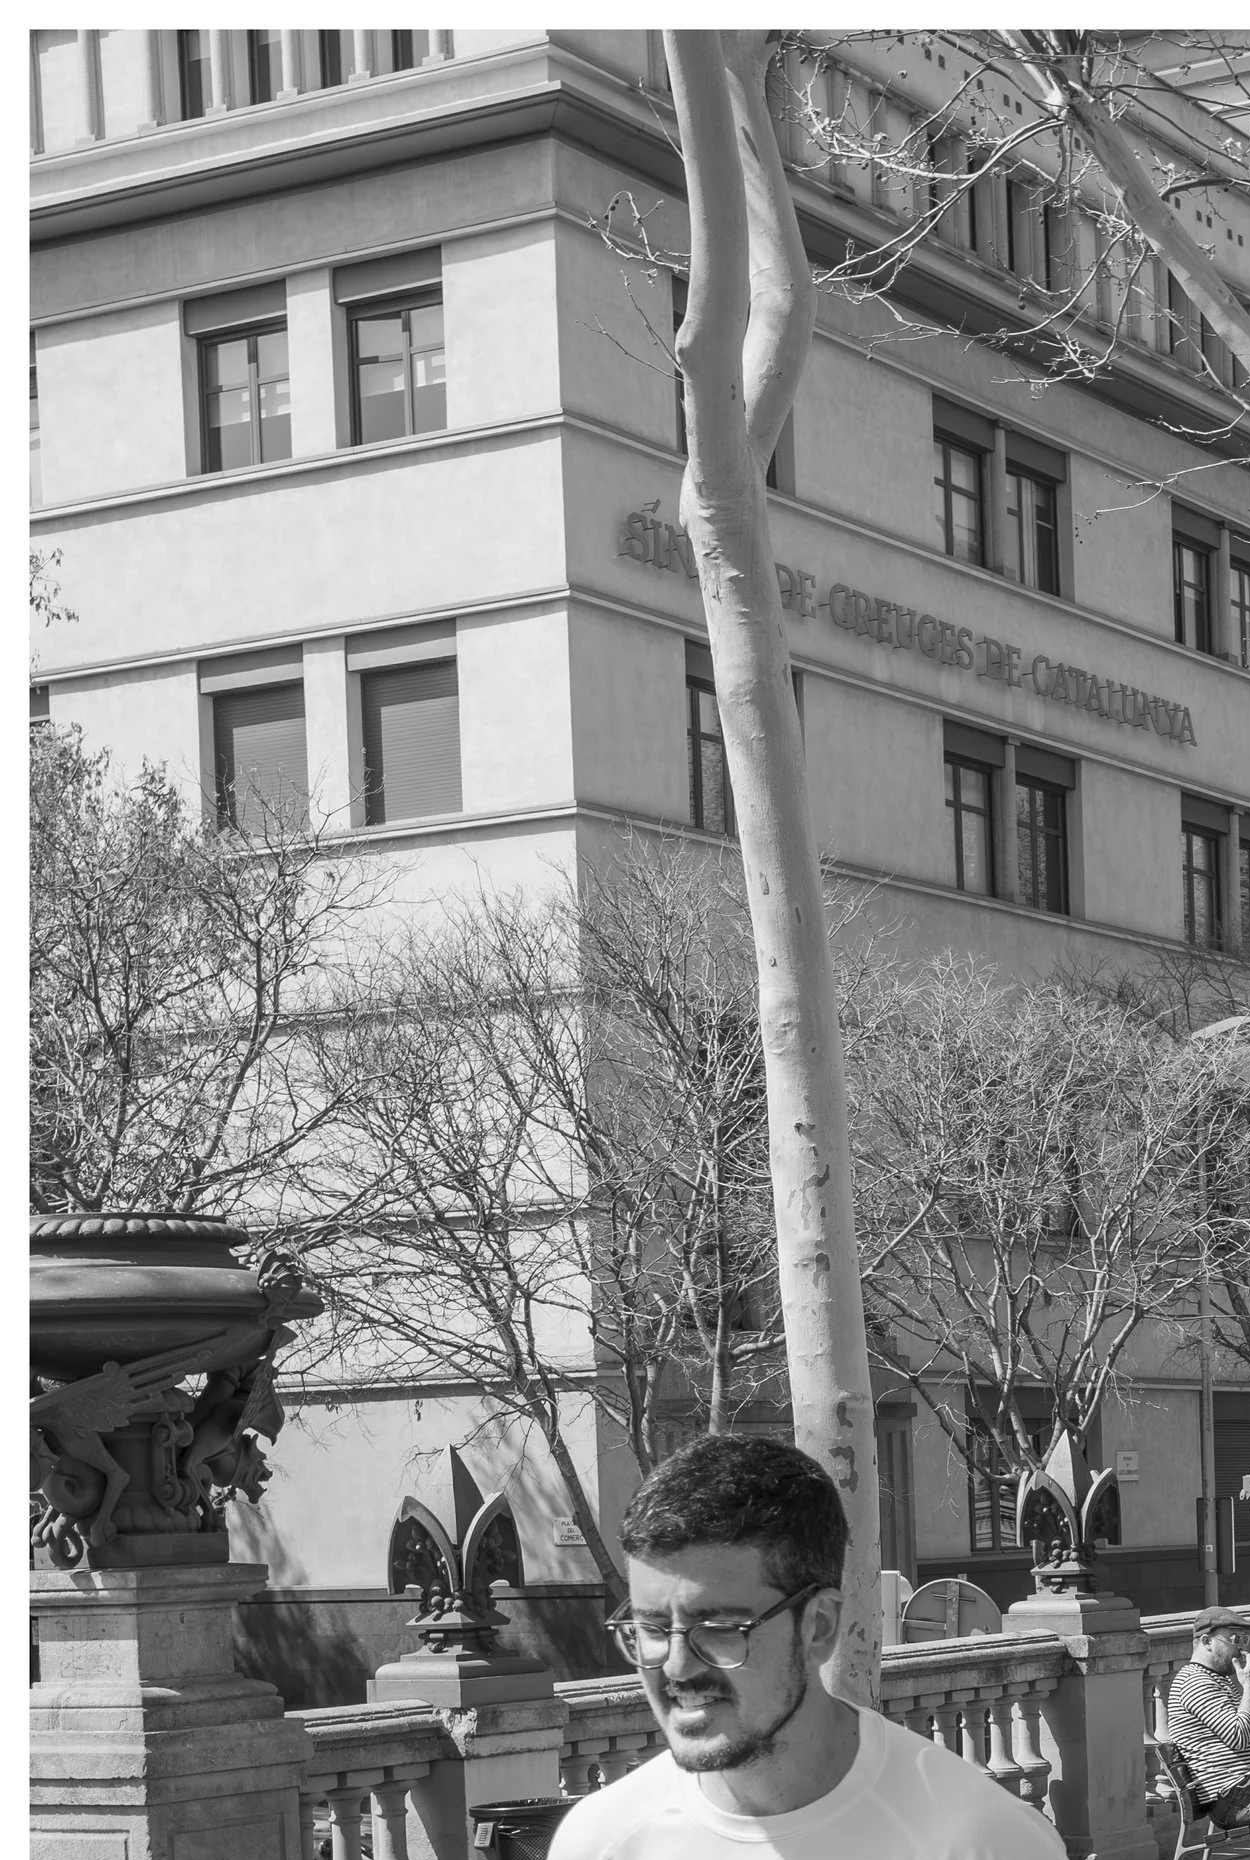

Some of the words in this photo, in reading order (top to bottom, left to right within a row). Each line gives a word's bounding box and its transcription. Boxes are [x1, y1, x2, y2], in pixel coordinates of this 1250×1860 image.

[622, 498, 699, 580] SÍN
[775, 562, 817, 619] DE
[829, 583, 974, 670] GREUGES
[984, 636, 1022, 688] DE
[1032, 655, 1197, 746] CATALUNYA
